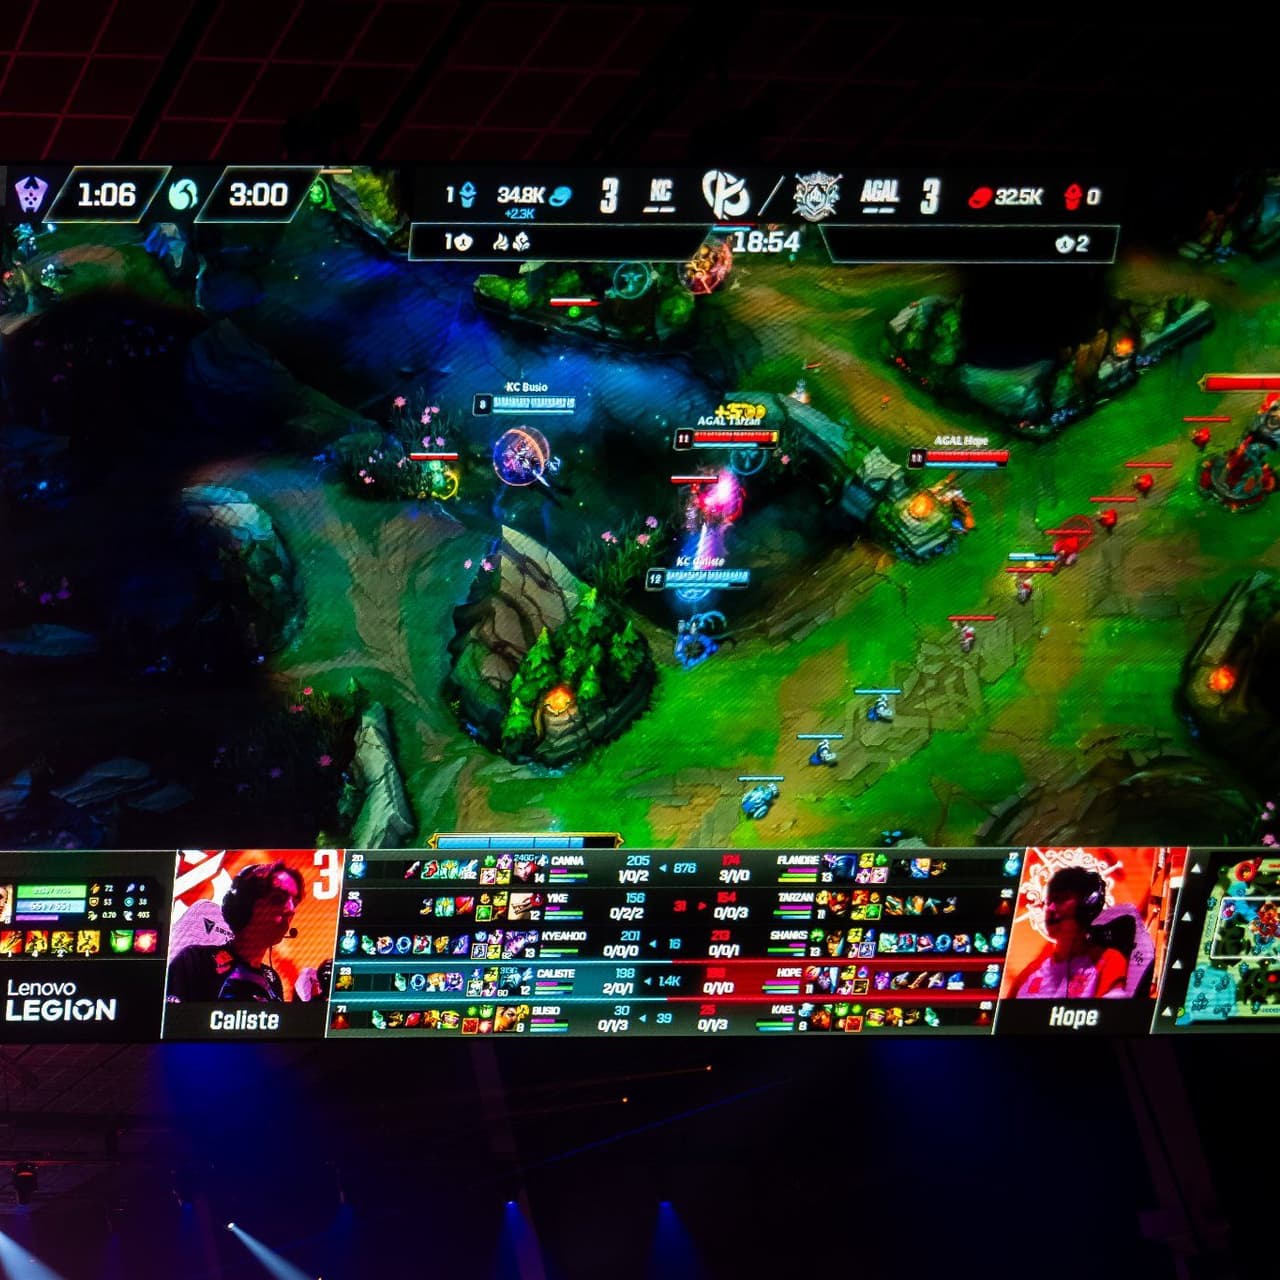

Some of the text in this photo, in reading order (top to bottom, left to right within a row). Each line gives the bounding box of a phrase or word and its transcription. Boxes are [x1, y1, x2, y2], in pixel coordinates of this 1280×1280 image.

[78, 183, 136, 207] 1:06
[229, 183, 288, 207] 3:00
[445, 187, 545, 204] 1 34.8K
[600, 177, 619, 214] 3
[649, 178, 673, 200] KC
[860, 179, 899, 203] AGAL
[920, 178, 940, 215] 3
[995, 188, 1043, 206] 32.5K
[1086, 188, 1101, 205] 0
[731, 231, 800, 253] 18:54
[1075, 235, 1089, 253] 2
[505, 382, 521, 392] KC
[626, 855, 650, 866] 205
[312, 849, 338, 899] 3
[618, 870, 649, 884] 1/0/2
[626, 893, 645, 903] 156
[610, 907, 644, 920] 0/2/2
[620, 931, 640, 941] 201
[603, 945, 639, 958] 0/0/0
[616, 968, 635, 978] 198
[6, 979, 76, 997] Lenovo
[603, 982, 633, 995] 2/0/1
[5, 999, 117, 1021] LEGION
[614, 1005, 630, 1016] 30
[1049, 1006, 1098, 1030] Hope
[210, 1010, 279, 1030] Caliste
[598, 1019, 629, 1033] 0/1/3
